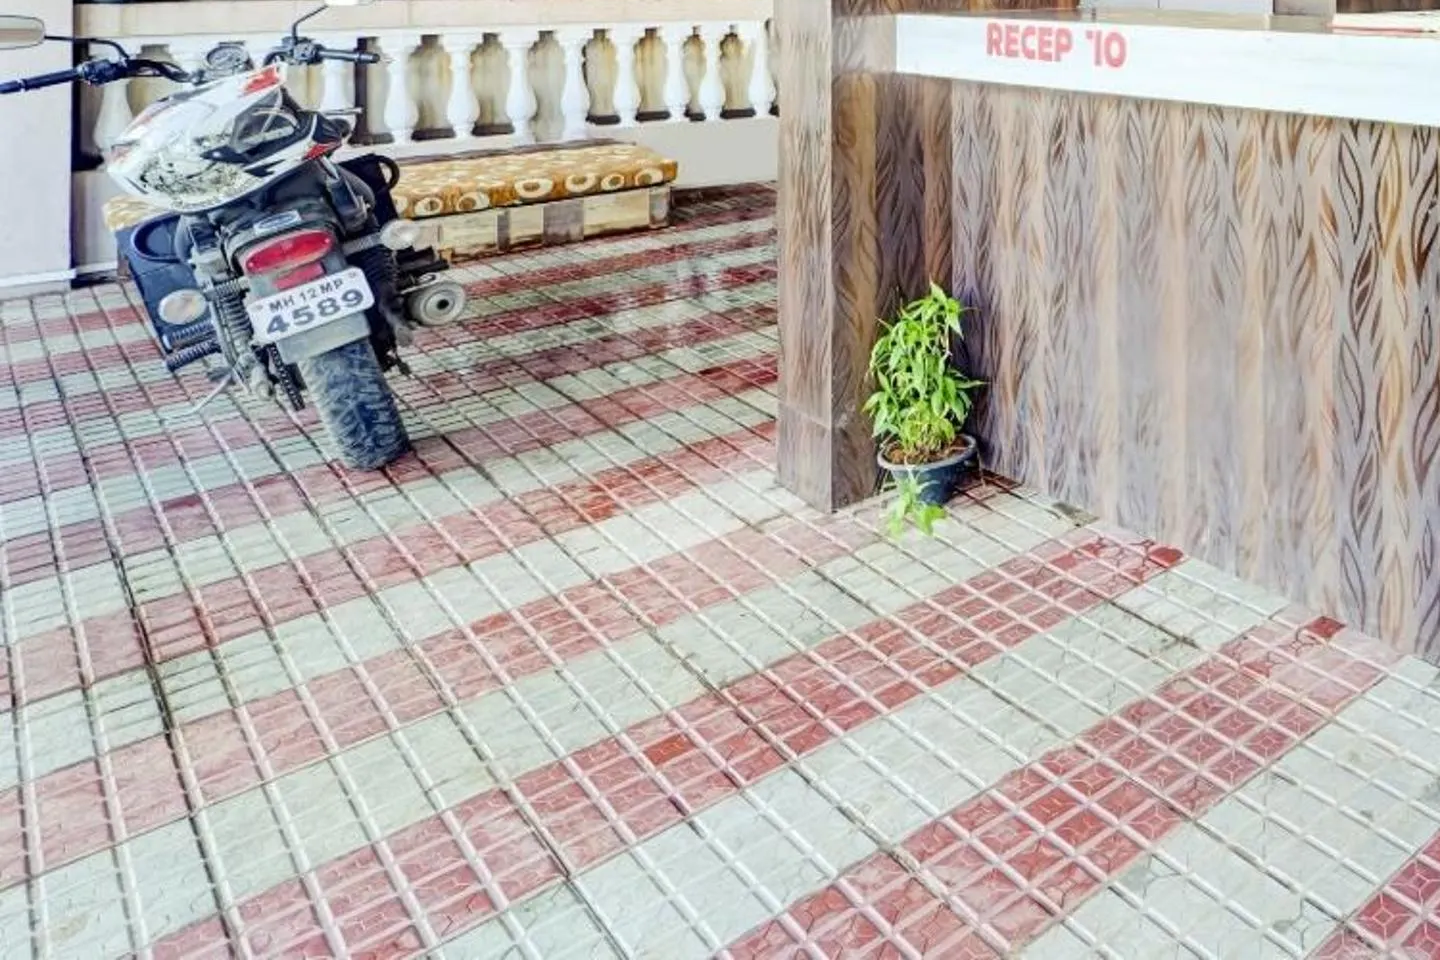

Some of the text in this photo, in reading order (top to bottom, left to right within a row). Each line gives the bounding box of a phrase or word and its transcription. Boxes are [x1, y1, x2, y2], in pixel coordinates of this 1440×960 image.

[986, 22, 1074, 62] RECEP
[266, 289, 364, 336] 4589
[268, 295, 295, 312] MH
[299, 288, 317, 301] 12
